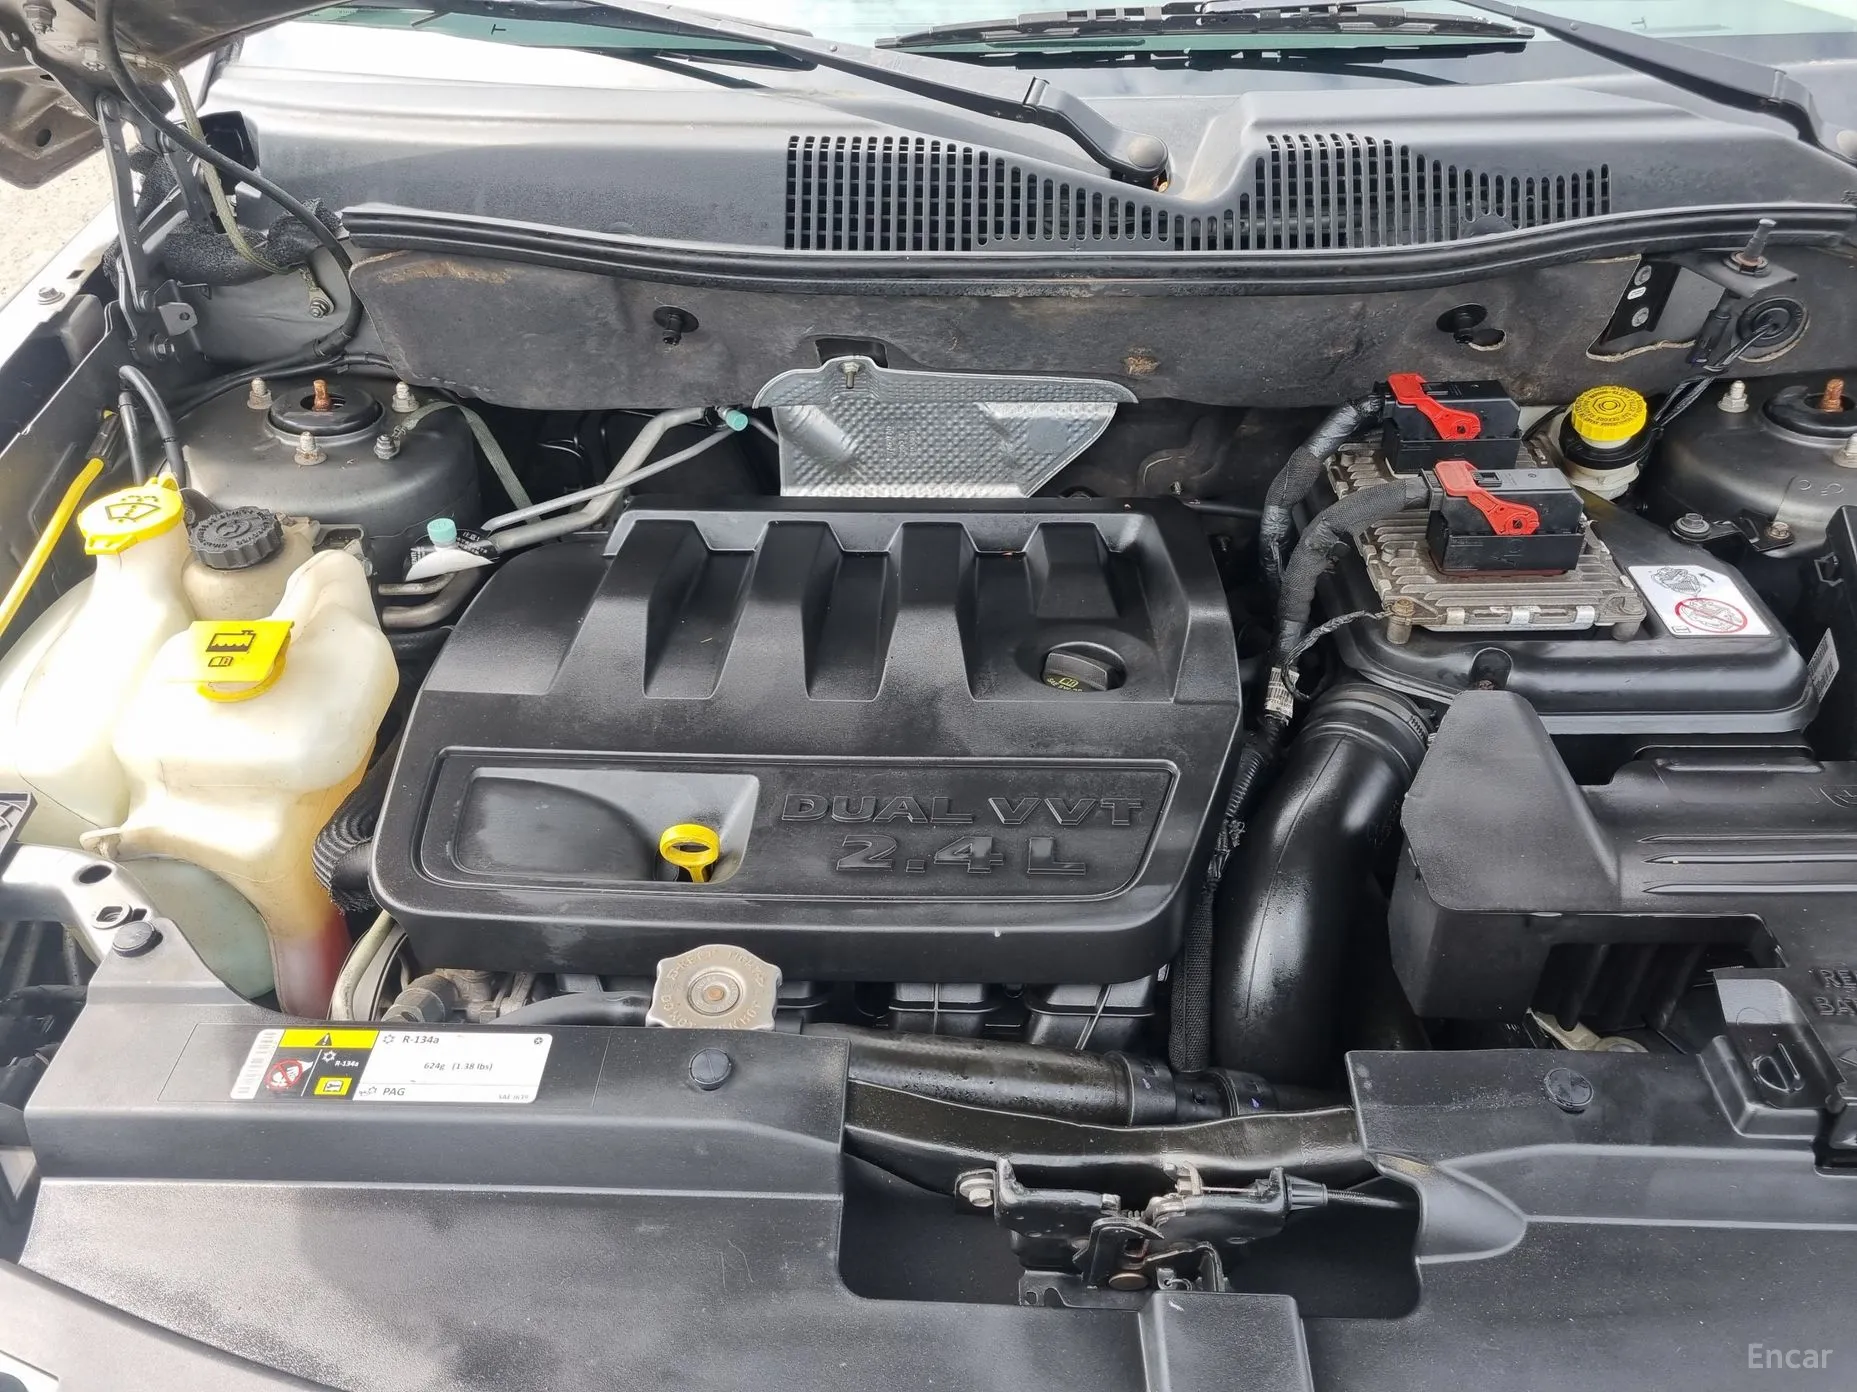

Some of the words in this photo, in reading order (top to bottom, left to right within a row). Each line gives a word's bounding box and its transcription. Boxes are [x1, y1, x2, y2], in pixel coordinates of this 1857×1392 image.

[781, 794, 974, 824] DUAL
[987, 797, 1143, 826] VVT
[1819, 968, 1857, 989] RE
[402, 1034, 440, 1045] R-134a
[334, 1060, 360, 1068] R-134a
[423, 1062, 446, 1071] 624g
[451, 1062, 475, 1071] (1.38
[476, 1062, 494, 1071] lbs)
[382, 1087, 406, 1097] PAG
